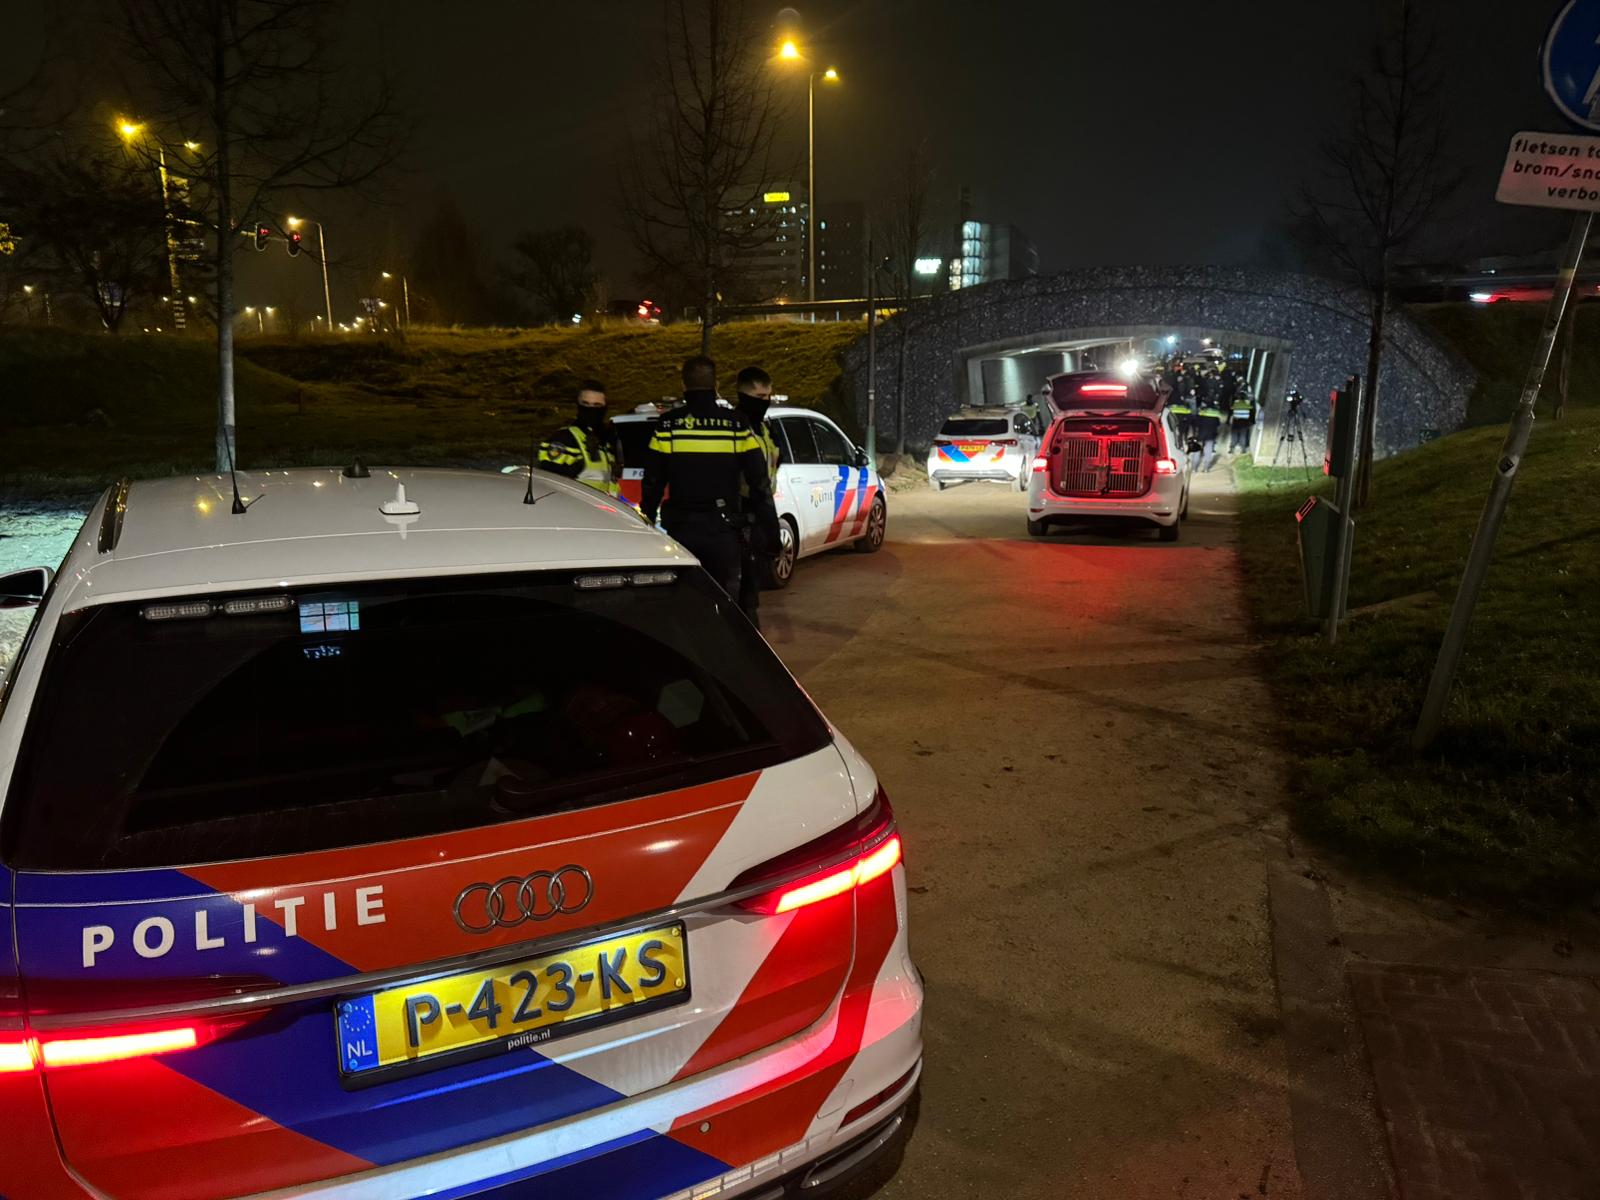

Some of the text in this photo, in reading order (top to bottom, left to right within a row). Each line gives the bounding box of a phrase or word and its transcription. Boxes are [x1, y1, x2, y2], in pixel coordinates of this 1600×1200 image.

[1514, 139, 1580, 156] fietsen
[1547, 186, 1600, 201] verbo
[82, 885, 387, 968] POLITIE
[405, 939, 668, 1048] P-423-KS
[347, 1038, 373, 1058] NL
[507, 1028, 551, 1051] politie.nl
